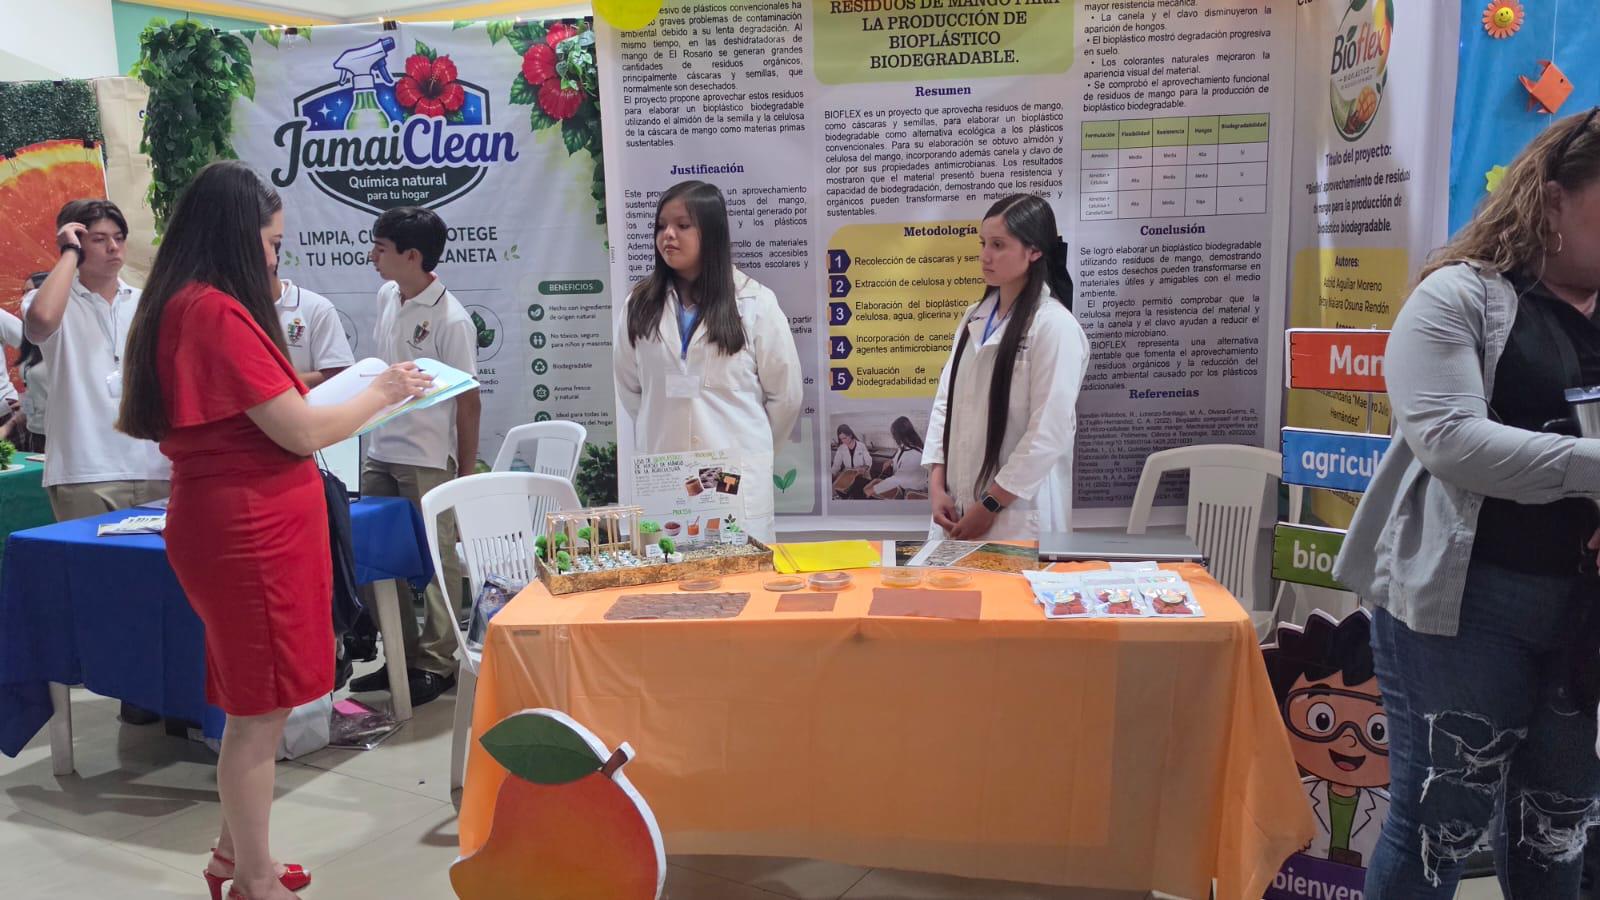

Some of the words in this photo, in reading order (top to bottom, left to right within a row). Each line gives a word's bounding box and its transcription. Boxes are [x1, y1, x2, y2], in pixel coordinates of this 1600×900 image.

[830, 0, 916, 14] RESIDUOS
[920, 0, 944, 9] DE
[863, 17, 883, 31] LA
[888, 9, 999, 30] PRODUCCIÓN
[1004, 11, 1027, 25] DE
[1101, 14, 1111, 22] La
[1152, 12, 1156, 20] y
[1163, 11, 1170, 19] el
[1177, 10, 1198, 18] clavo
[1205, 8, 1257, 18] disminuyeron
[889, 30, 1000, 49] BIOPLÁSTICO
[870, 50, 1019, 69] BIODEGRADABLE.
[1094, 81, 1105, 89] Se
[1109, 79, 1148, 89] comprobó
[1162, 76, 1230, 86] aprovechamiento
[1233, 74, 1270, 83] funcional
[915, 85, 971, 96] Resumen
[624, 96, 631, 104] El
[635, 95, 668, 106] proyecto
[670, 94, 699, 104] propone
[703, 92, 745, 103] aprovechar
[625, 107, 641, 115] para
[649, 106, 679, 114] elaborar
[703, 103, 743, 113] bioplástico
[751, 101, 804, 111] biodegradable
[824, 110, 861, 119] BIOFLEX
[888, 107, 922, 118] proyecto
[925, 107, 939, 116] que
[942, 104, 983, 115] aprovecha
[985, 103, 1018, 111] residuos
[1022, 102, 1031, 110] de
[271, 117, 519, 188] JamaiClean
[670, 163, 744, 175] Justificación
[349, 175, 399, 189] Química
[402, 173, 447, 186] natural
[367, 193, 388, 201] para
[402, 190, 429, 200] hogar
[742, 186, 806, 195] aprovechamiento
[904, 225, 978, 237] Metodología
[1140, 224, 1205, 235] Conclusión
[1341, 218, 1391, 235] biodegradable.
[299, 230, 354, 245] LIMPIA,
[446, 227, 497, 241] OTEGE
[1080, 247, 1091, 255] Se
[1116, 245, 1148, 254] elaborar
[1162, 243, 1203, 253] bioplástico
[1205, 241, 1261, 251] biodegradable
[306, 253, 326, 266] TU
[332, 251, 371, 265] HOG
[438, 248, 497, 263] ANETA
[835, 256, 841, 267] 1
[855, 256, 904, 265] Recolección
[906, 256, 916, 264] de
[957, 255, 961, 263] y
[1335, 256, 1359, 267] Autores:
[549, 283, 592, 291] BENEFICIOS
[836, 281, 844, 293] 2
[855, 279, 896, 288] Extracción
[912, 278, 945, 286] celulosa
[947, 278, 951, 286] y
[856, 301, 902, 310] Elaboración
[926, 299, 968, 308] bioplástico
[1103, 299, 1135, 308] proyecto
[1142, 297, 1173, 307] permitió
[1180, 296, 1222, 305] comprobar
[1229, 296, 1245, 304] que
[836, 308, 844, 320] 3
[918, 311, 952, 320] glicerina
[954, 312, 958, 320] y
[856, 334, 909, 343] Incorporación
[1091, 341, 1126, 349] BIOFLEX
[1138, 339, 1179, 348] representa
[1217, 337, 1258, 345] alternativa
[836, 342, 845, 354] 4
[857, 346, 887, 355] agentes
[553, 362, 592, 370] Biodegradable
[1329, 344, 1385, 376] Man
[857, 367, 900, 375] Evaluación
[838, 373, 846, 385] 5
[857, 377, 926, 387] biodegradabilidad
[1129, 389, 1199, 399] Referencias
[1293, 540, 1332, 572] bio
[1273, 867, 1363, 900] bienven
